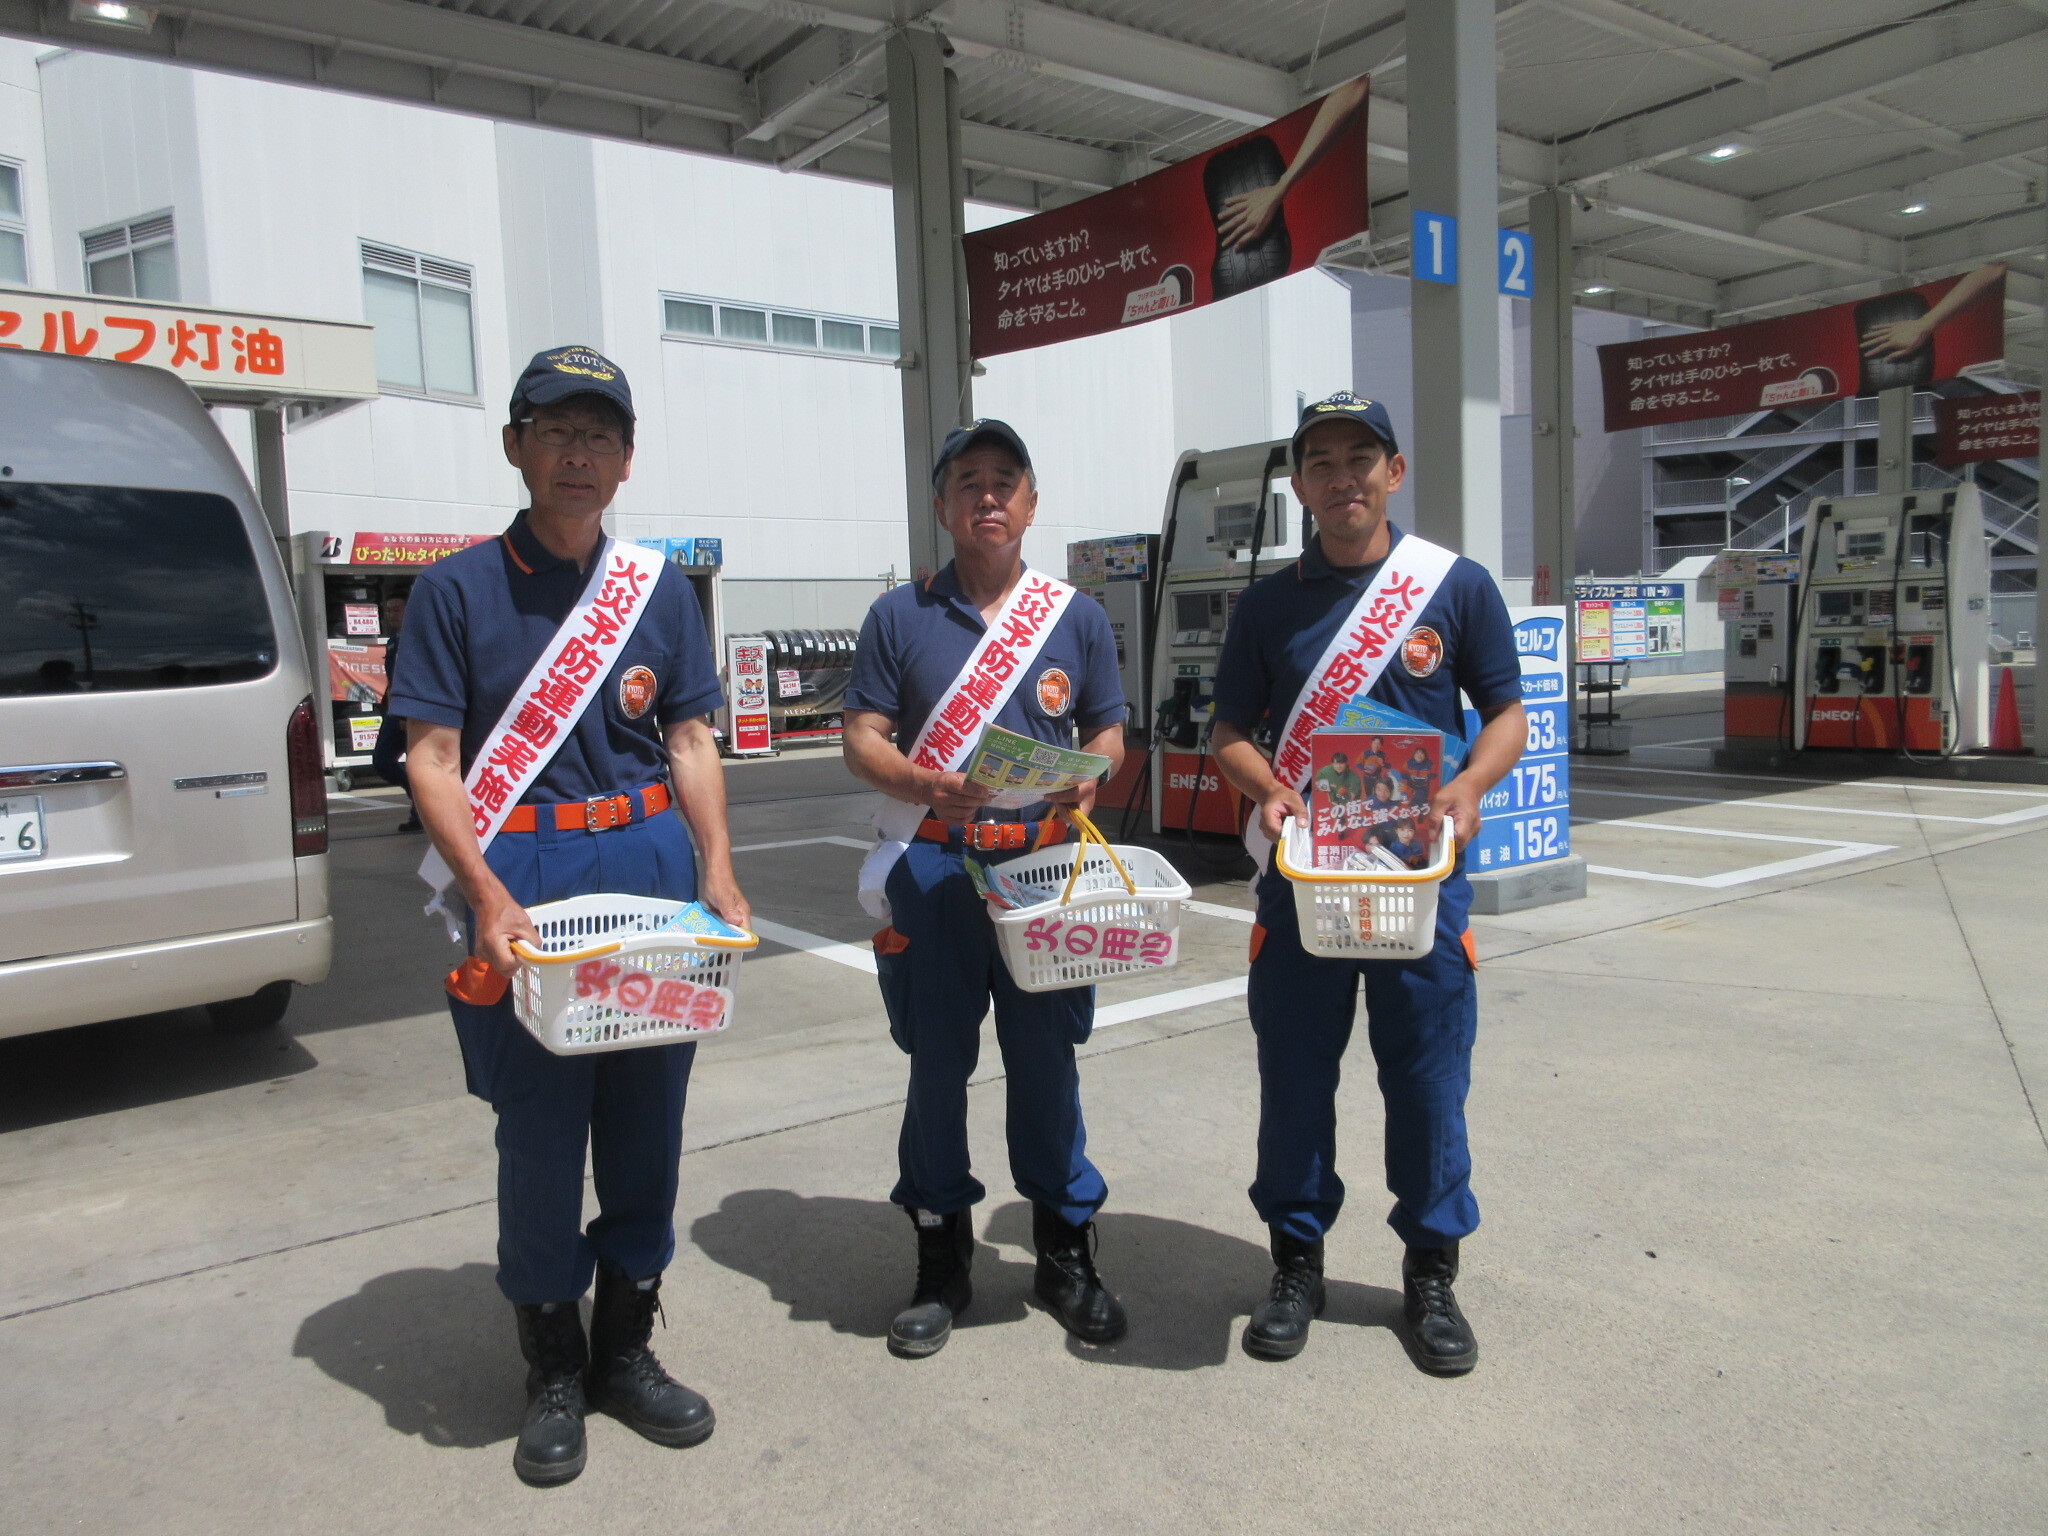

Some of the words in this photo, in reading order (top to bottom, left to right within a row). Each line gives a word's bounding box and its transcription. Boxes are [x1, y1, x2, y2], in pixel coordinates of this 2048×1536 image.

[1429, 220, 1442, 275] 1
[1504, 237, 1525, 291] 2
[997, 298, 1087, 330] 命を守ること。
[563, 353, 606, 373] KYOTO
[1408, 643, 1428, 653] KYOTO
[1514, 628, 1557, 652] セルフ
[736, 646, 763, 660] キズ
[737, 661, 763, 675] 直し
[627, 684, 645, 694] KYOTO
[1042, 684, 1059, 694] KYOTO
[784, 708, 817, 716] ALENZA
[1812, 710, 1860, 721] ENEOS
[997, 735, 1018, 746] LINE
[1170, 773, 1218, 791] ENEOS
[1513, 763, 1557, 807] 175
[1514, 817, 1558, 860] 152
[1023, 917, 1172, 965] 火の用心
[575, 959, 726, 1029] 火の用心
